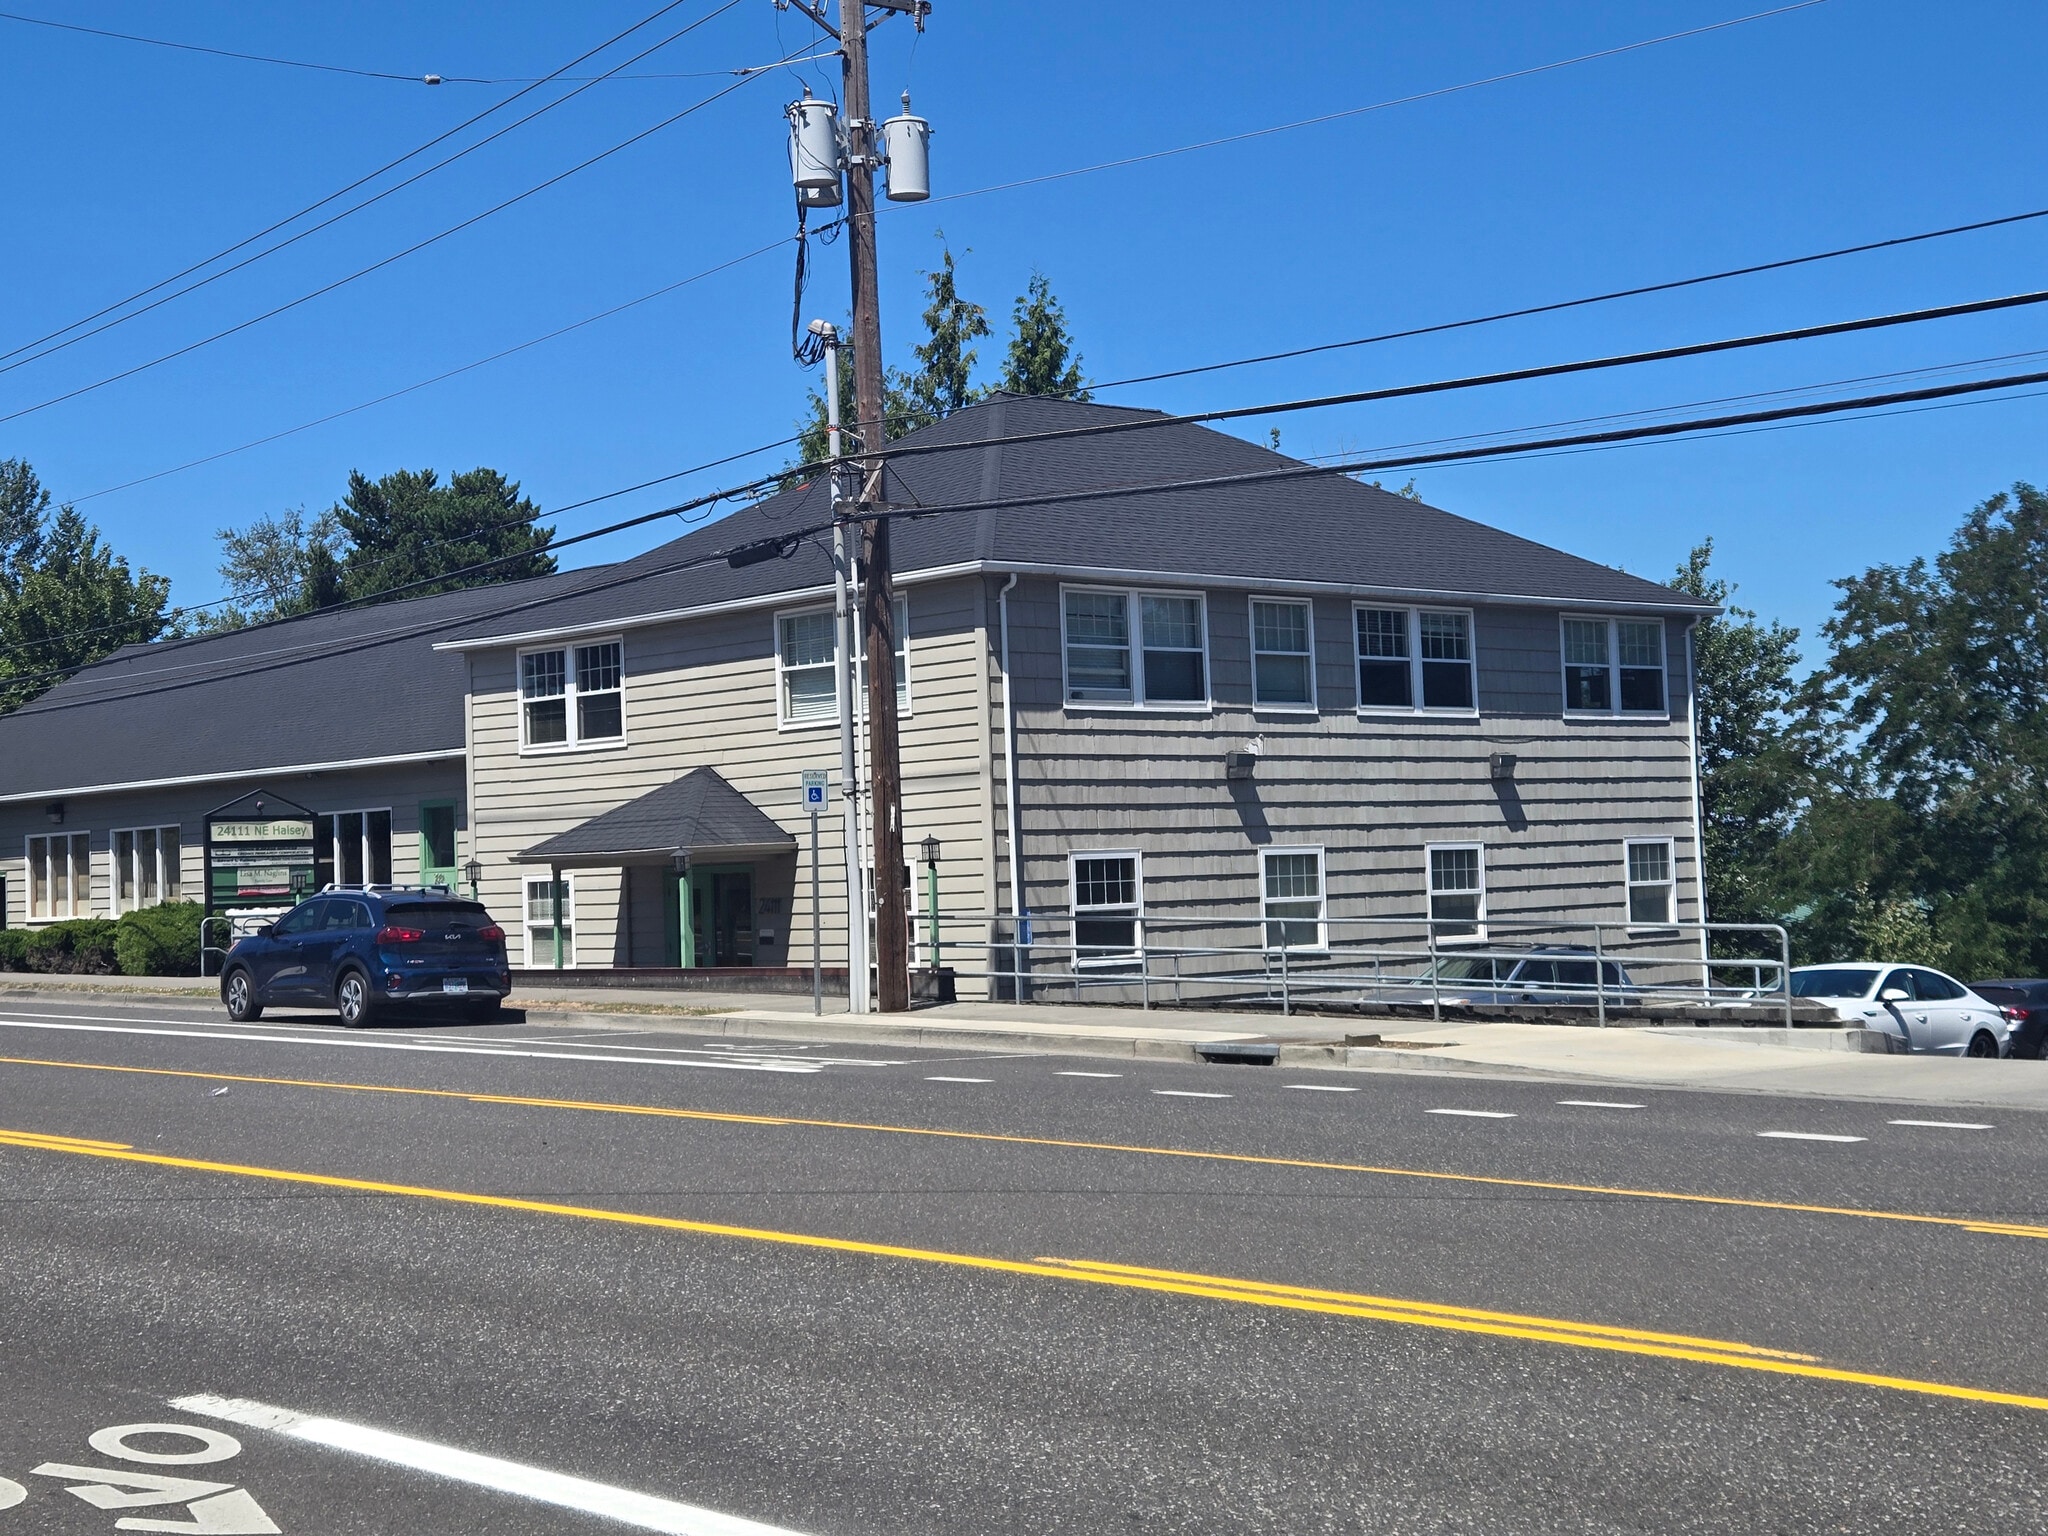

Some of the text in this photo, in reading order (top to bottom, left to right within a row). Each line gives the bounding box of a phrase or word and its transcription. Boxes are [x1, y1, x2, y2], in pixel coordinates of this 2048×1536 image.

[217, 825, 307, 837] 24111 NE Halsey
